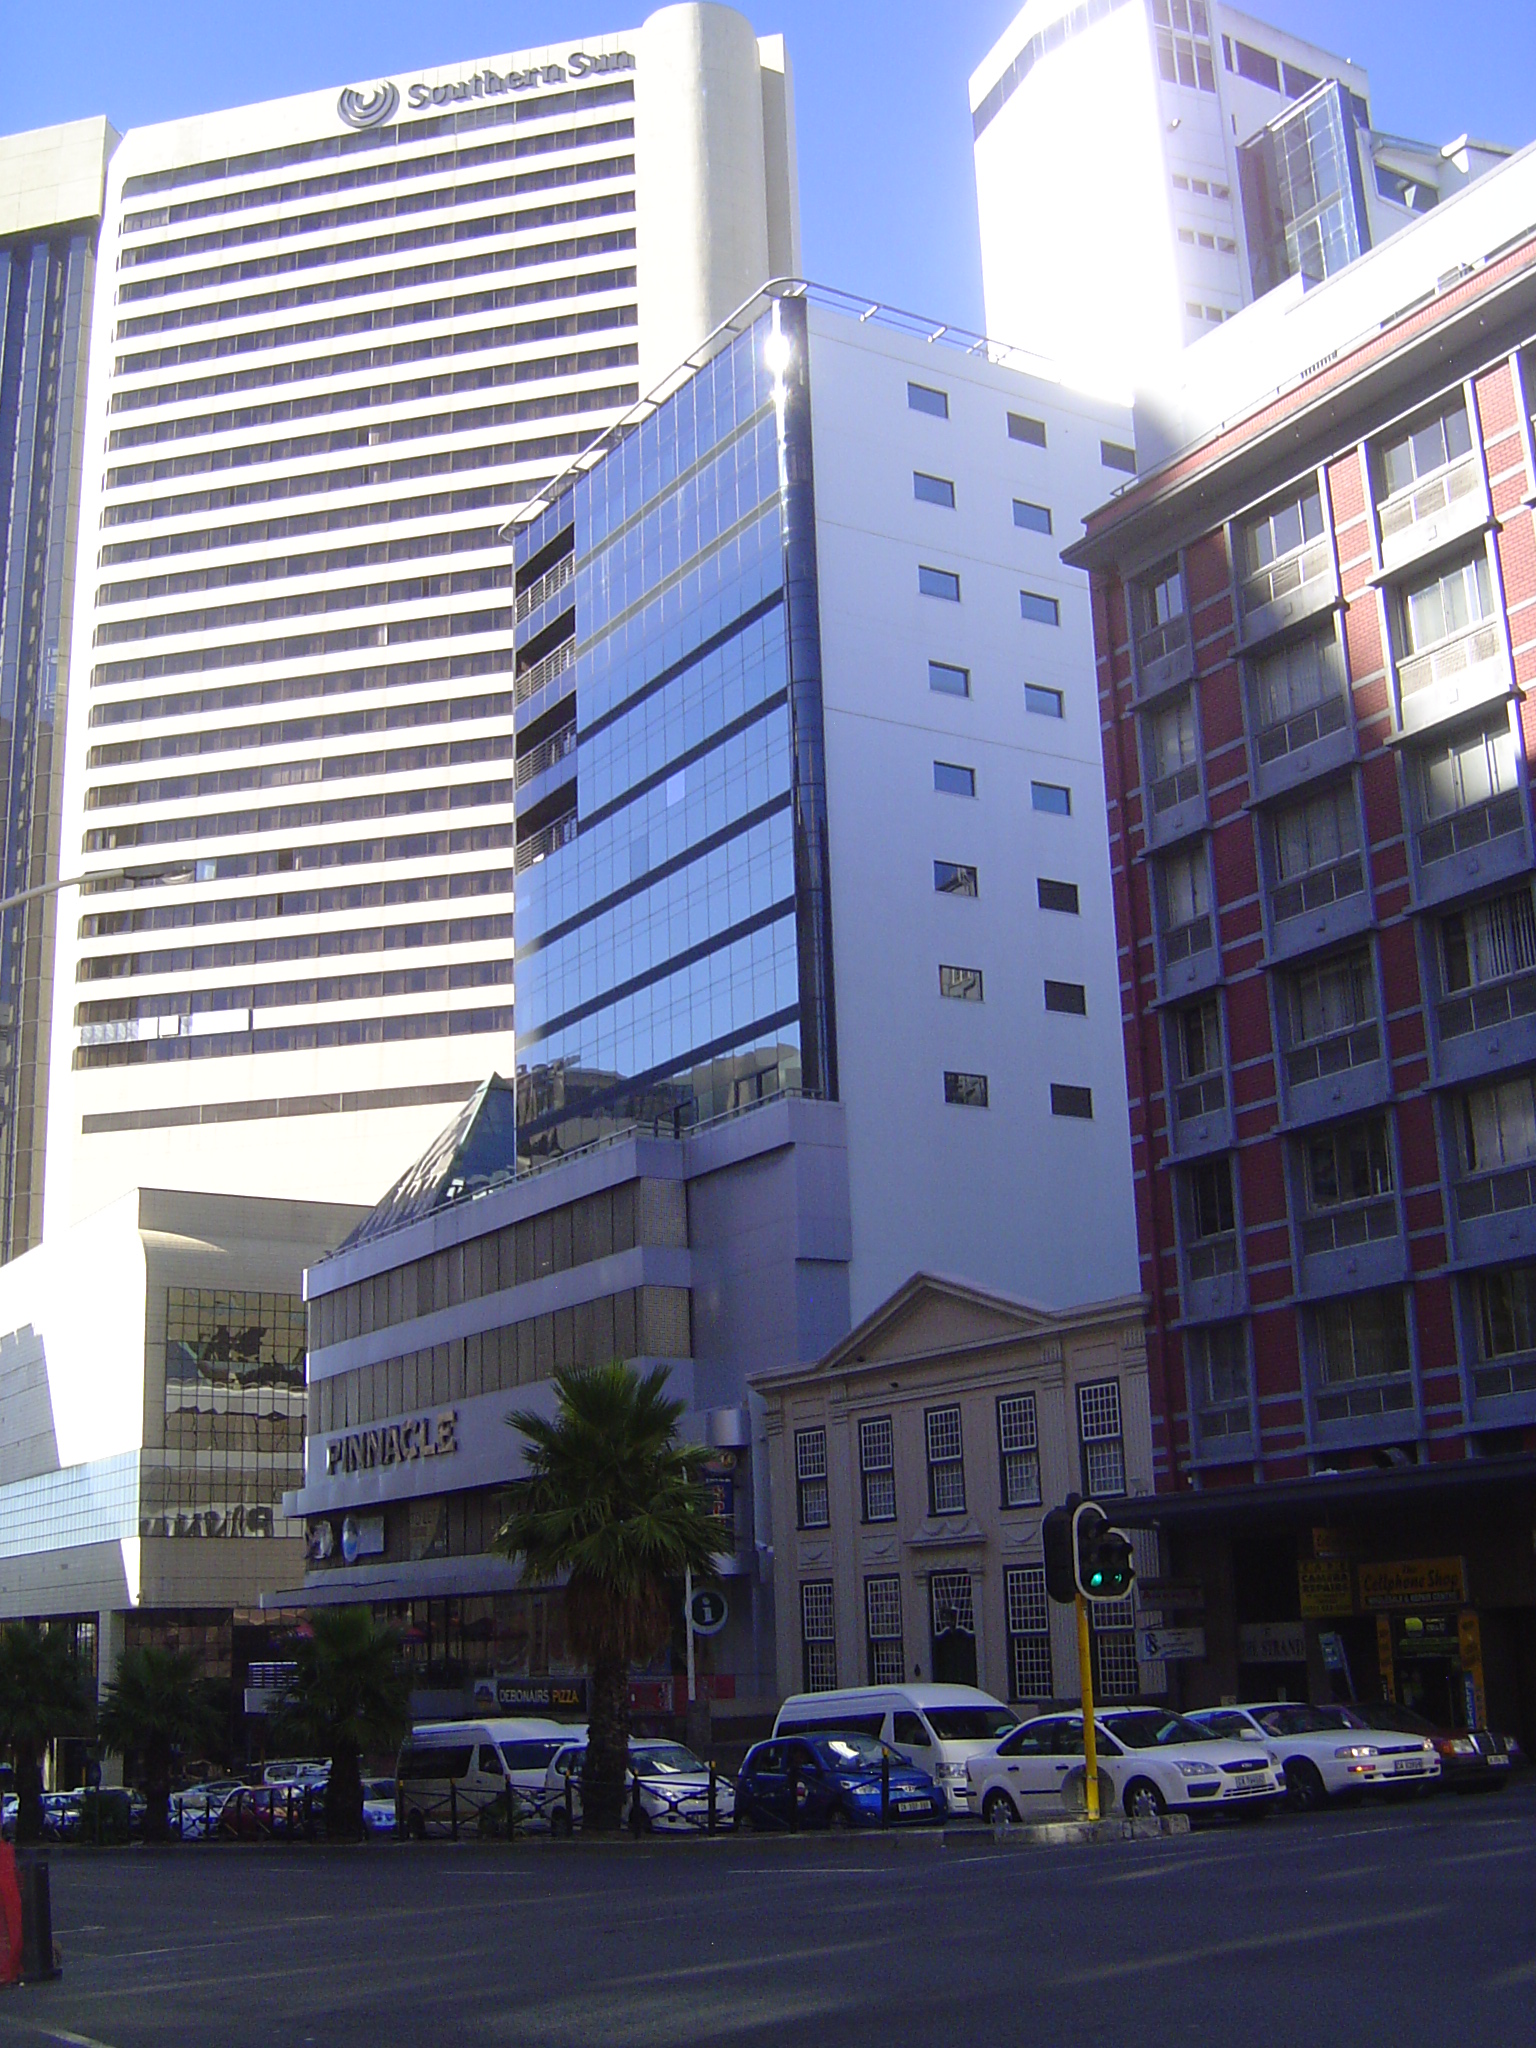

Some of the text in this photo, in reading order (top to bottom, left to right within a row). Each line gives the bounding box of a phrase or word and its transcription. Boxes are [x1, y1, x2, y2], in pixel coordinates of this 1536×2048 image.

[408, 50, 637, 109] Southern Sun
[326, 1410, 458, 1476] PINNACLE
[1364, 1568, 1458, 1593] Cellphone Shop
[500, 1688, 580, 1704] DEBONAIRS PIZZA
